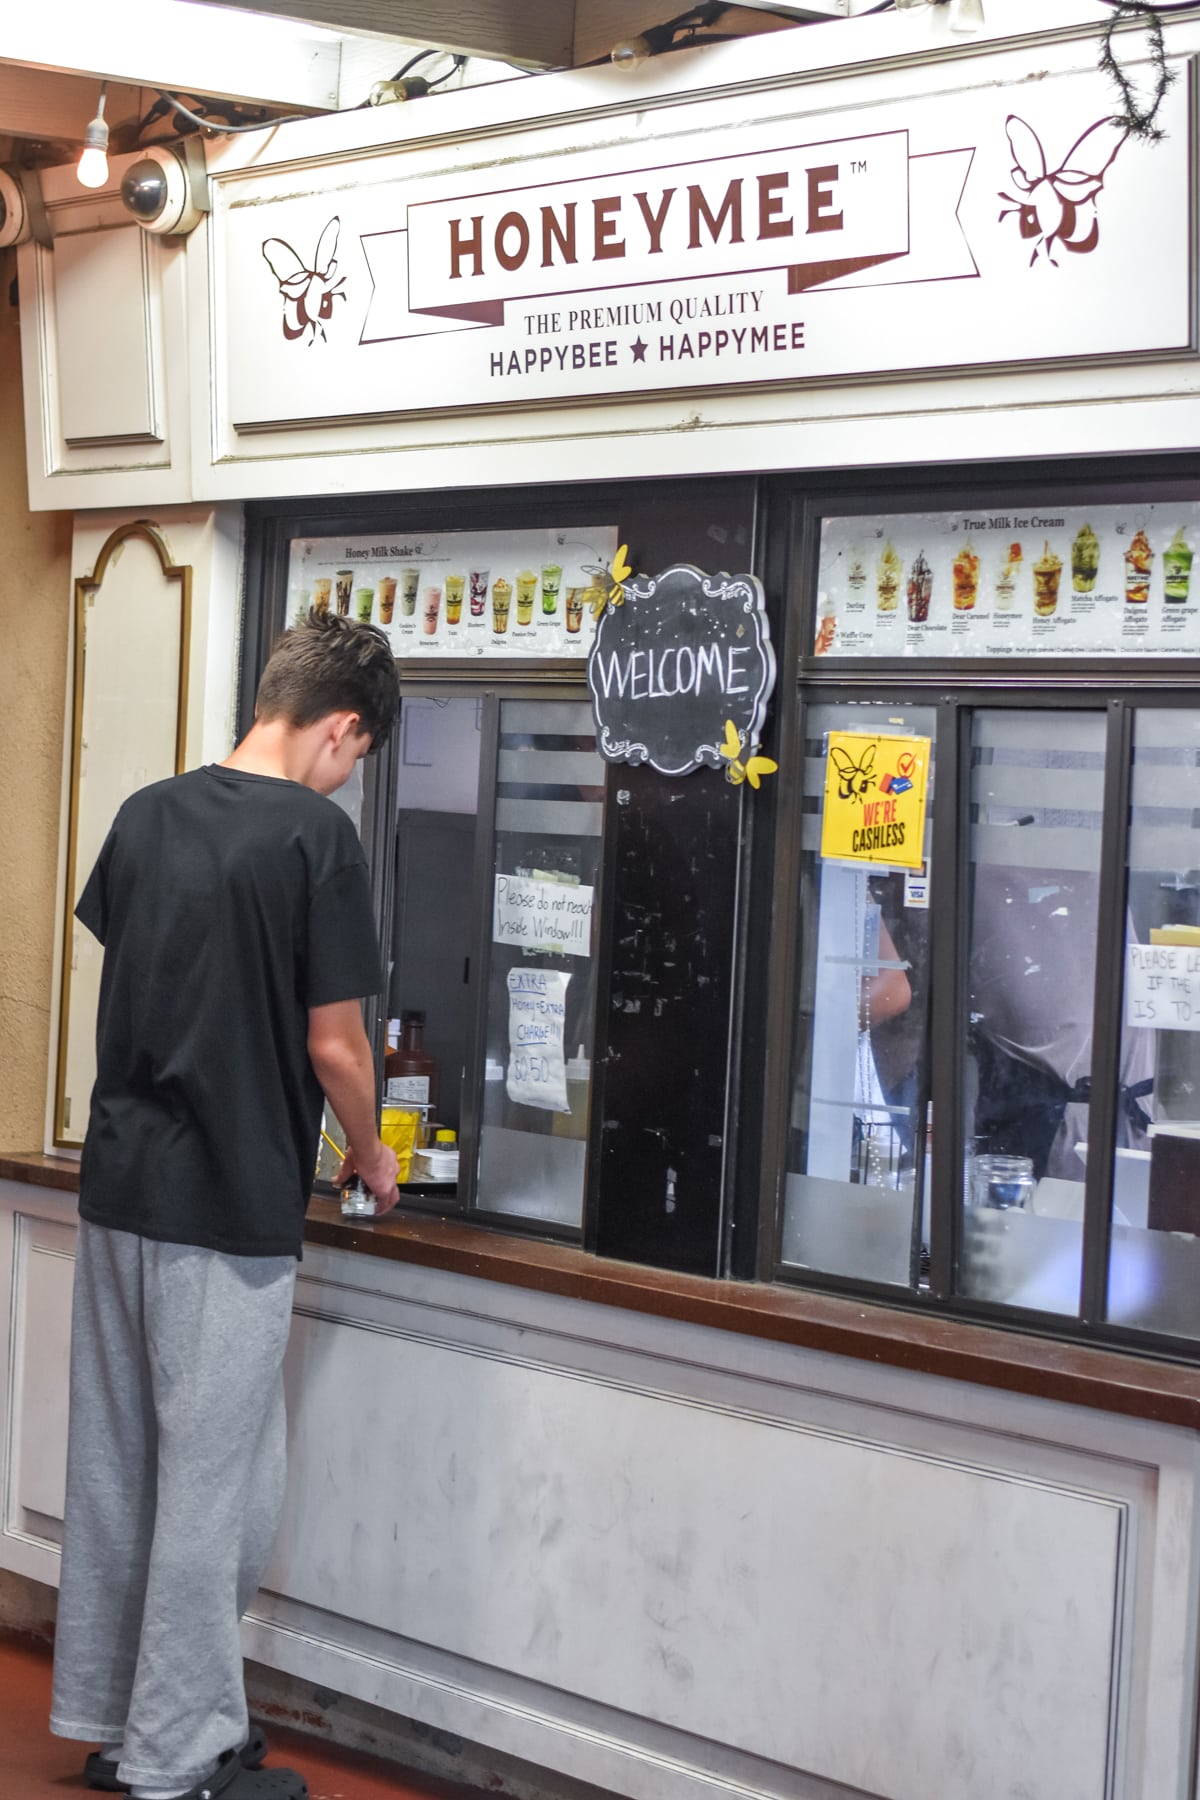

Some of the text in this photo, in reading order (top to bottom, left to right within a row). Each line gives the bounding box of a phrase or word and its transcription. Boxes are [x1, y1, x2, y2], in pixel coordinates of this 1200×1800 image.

[449, 164, 844, 279] HONEYMEE
[524, 290, 764, 335] THE PREMIUM QUALITY
[490, 322, 805, 376] HAPPYBEE HAPPYMEE
[963, 516, 1065, 530] True Milk Ice Cream
[345, 545, 414, 559] Honey Milk Shake
[597, 643, 751, 700] WELCOME
[863, 799, 897, 827] WE'RE
[852, 822, 905, 852] CASHLESS
[497, 877, 535, 908] Please
[537, 888, 548, 910] do
[552, 894, 566, 911] not
[1131, 947, 1176, 970] PLEASE
[510, 973, 547, 990] EXTRA
[1146, 976, 1191, 994] IF THE
[1133, 1000, 1156, 1019] IS
